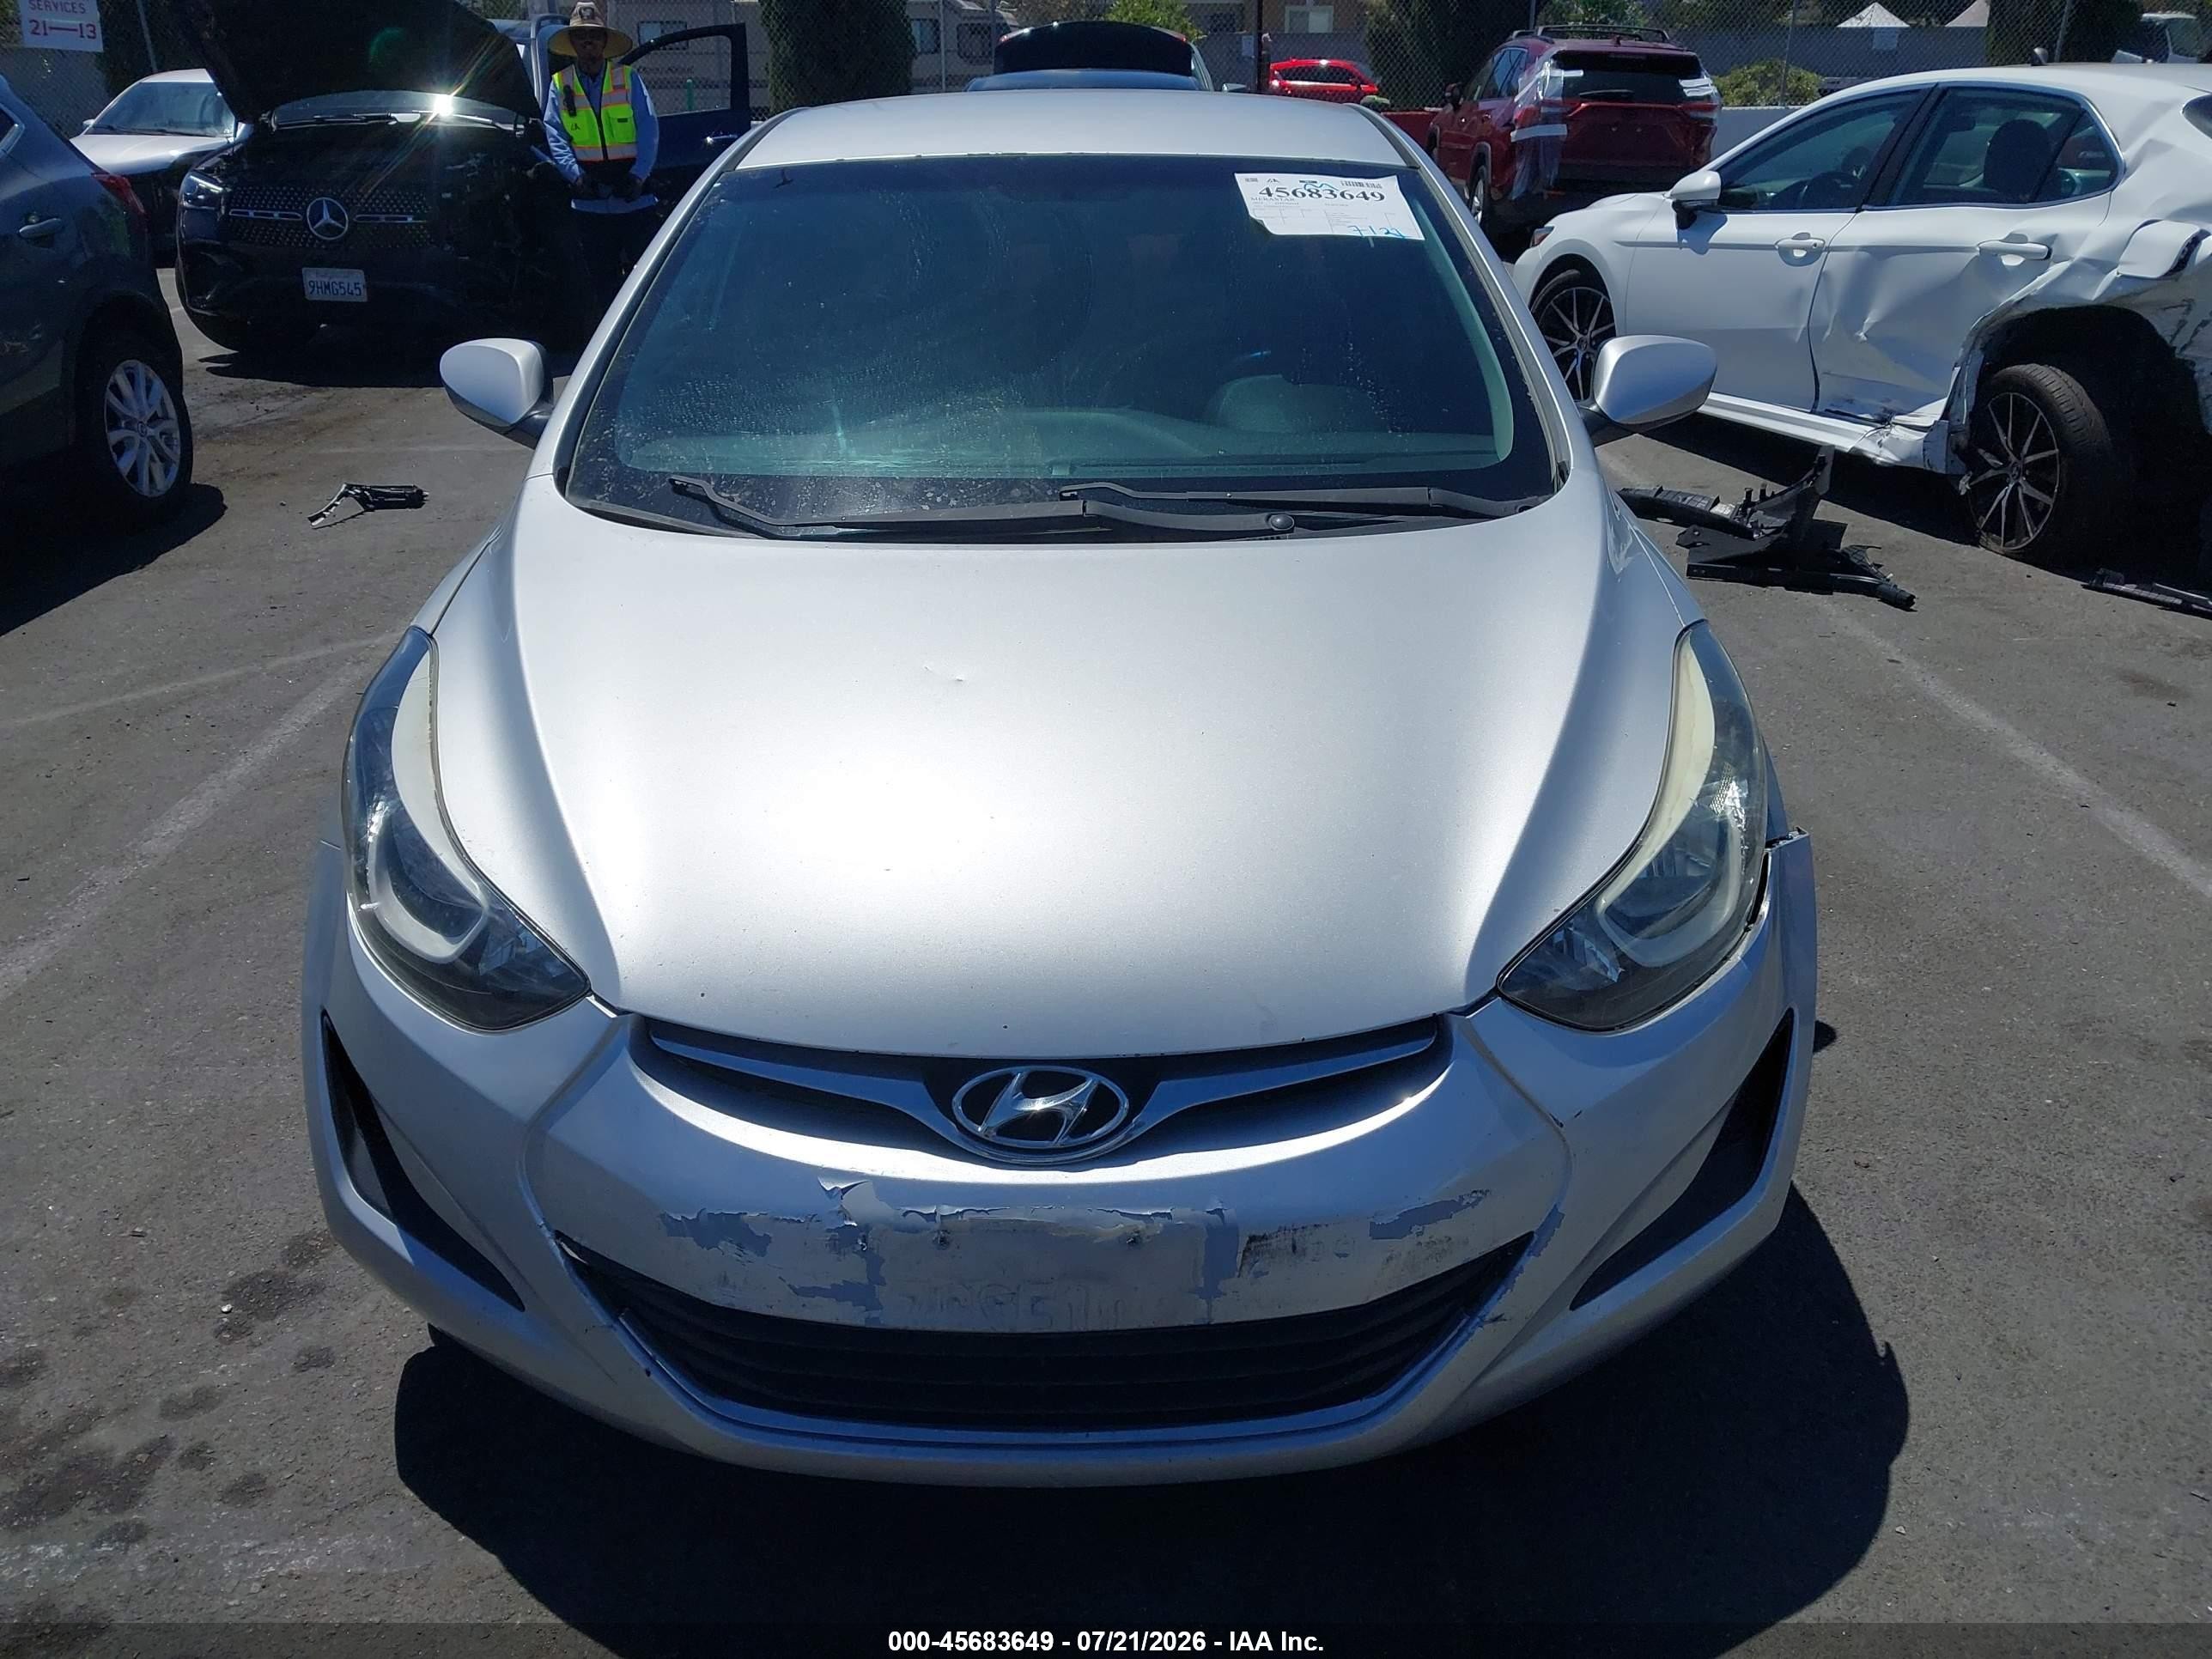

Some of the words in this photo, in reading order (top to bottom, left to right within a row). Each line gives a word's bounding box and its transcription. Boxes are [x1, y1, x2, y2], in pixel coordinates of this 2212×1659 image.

[28, 0, 87, 14] SERVICES
[1259, 186, 1385, 202] 45683649
[308, 280, 362, 296] 9HMG545
